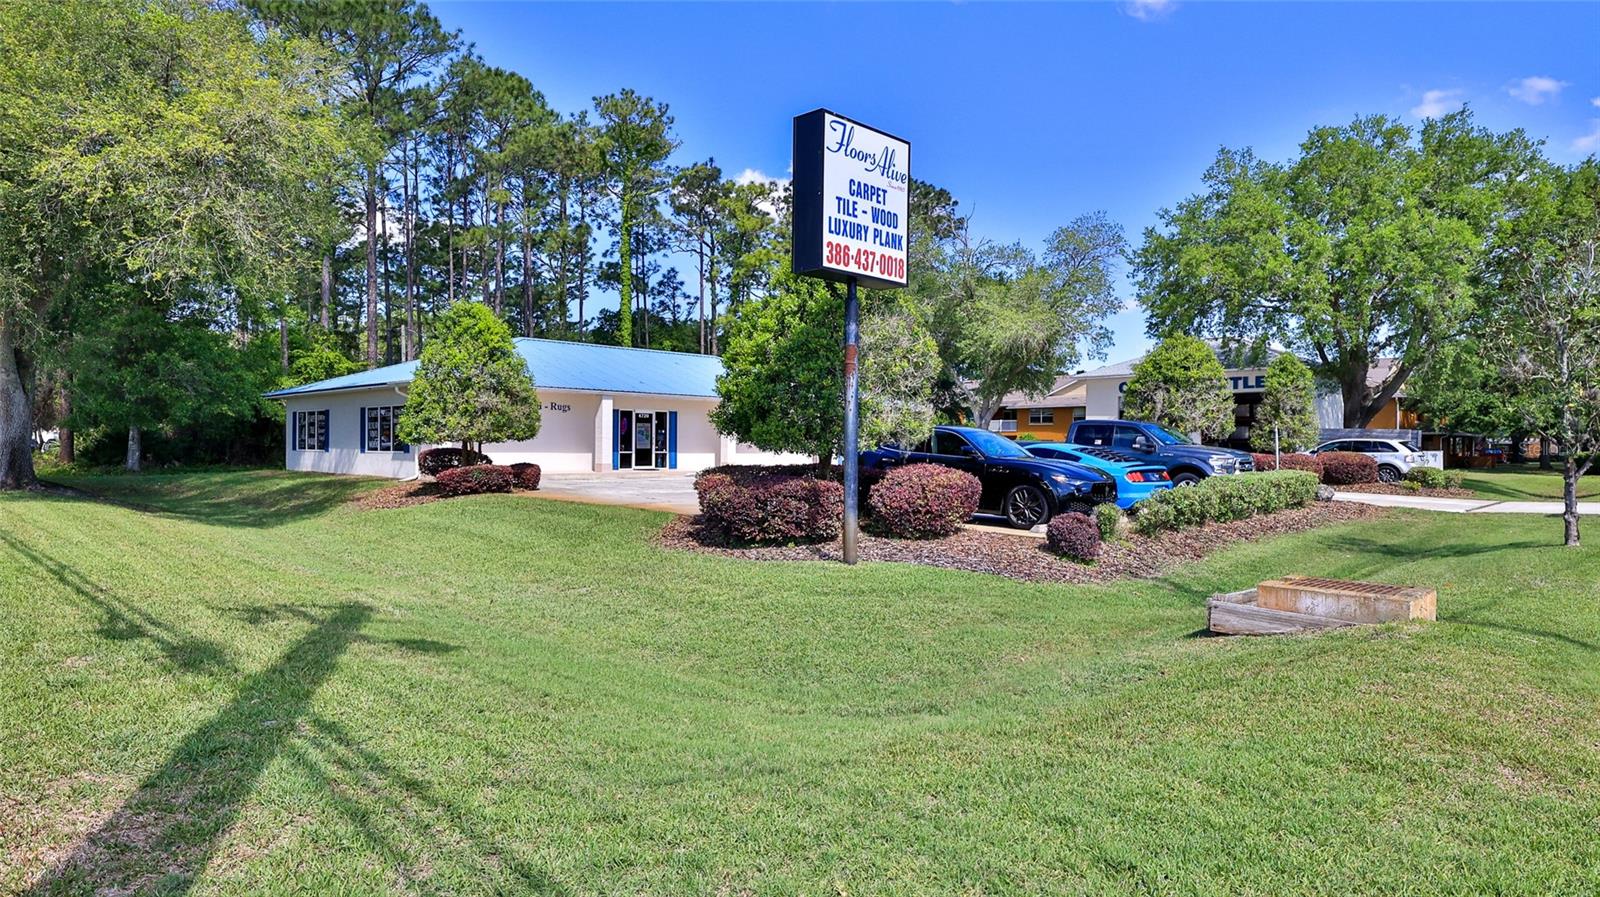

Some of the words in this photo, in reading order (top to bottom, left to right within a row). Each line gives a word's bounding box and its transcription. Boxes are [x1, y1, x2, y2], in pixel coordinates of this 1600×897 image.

[849, 178, 888, 206] CARPET
[836, 196, 858, 219] TILE
[871, 206, 898, 229] WOOD
[828, 216, 870, 242] LUXURY
[873, 230, 904, 251] PLANK
[1230, 376, 1265, 389] TLE
[550, 402, 571, 413] Rugs
